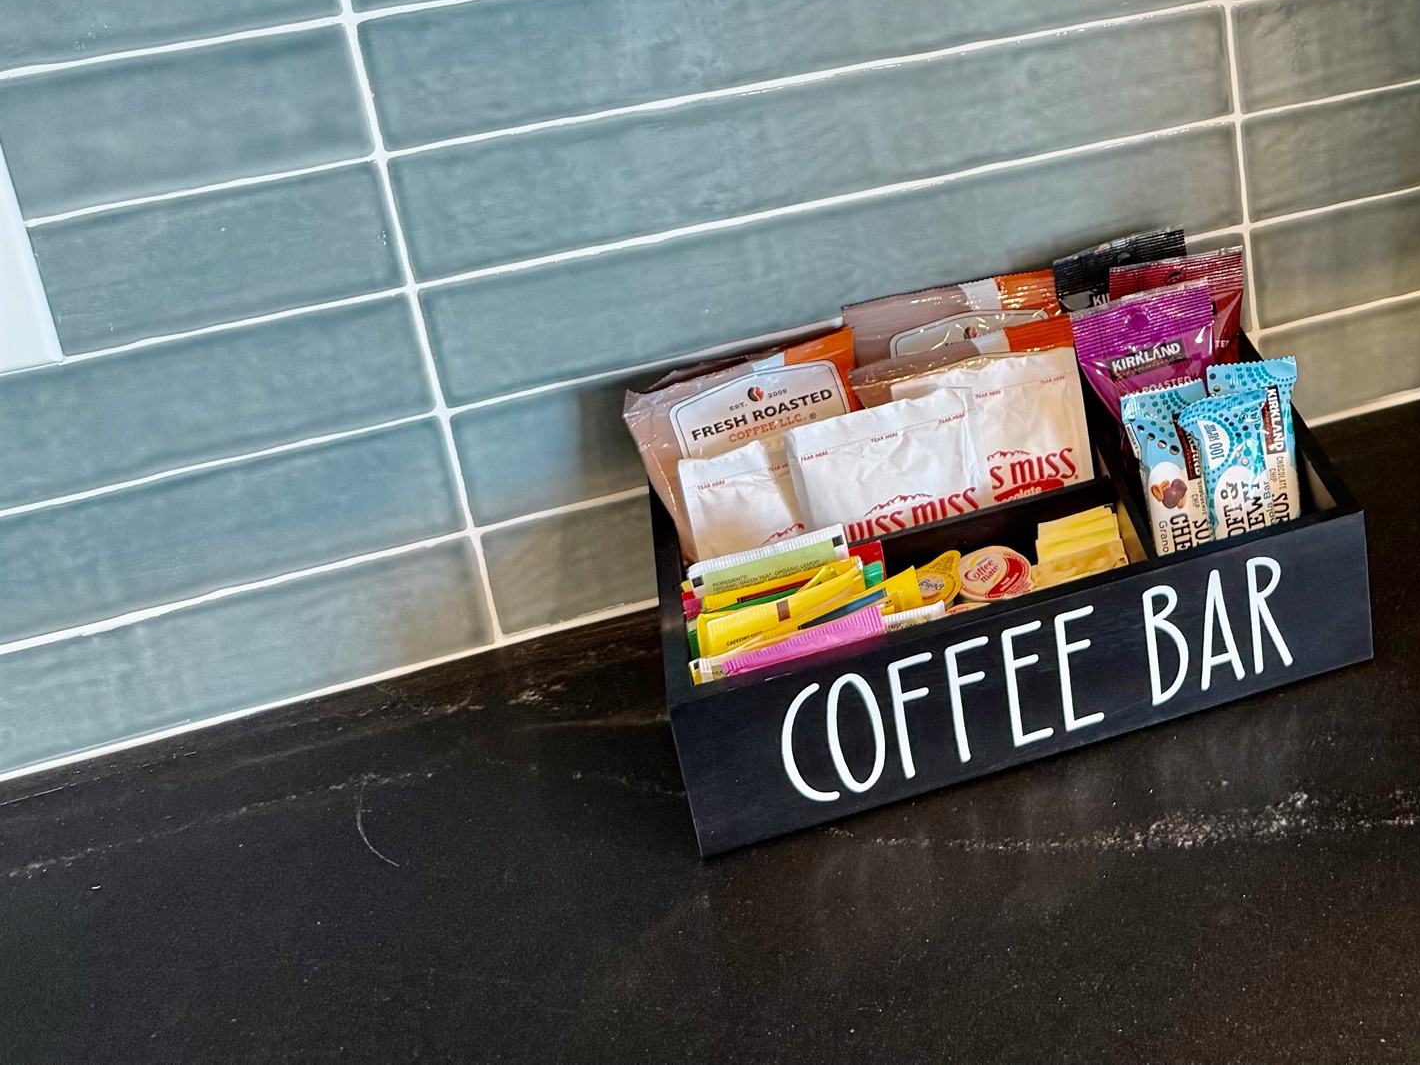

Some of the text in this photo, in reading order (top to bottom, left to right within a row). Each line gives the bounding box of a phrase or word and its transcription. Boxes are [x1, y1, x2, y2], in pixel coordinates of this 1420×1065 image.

[1111, 342, 1182, 373] KIRKLAND
[729, 387, 788, 412] EST. 2009
[691, 388, 833, 442] FRESH ROASTED
[728, 413, 807, 444] COFFEE LLC.
[1266, 386, 1284, 451] KIRKLAND
[1208, 442, 1225, 460] 100
[1010, 447, 1077, 486] MISS
[1268, 467, 1278, 483] CHIP
[1275, 455, 1288, 491] CHOCOLATE
[1191, 493, 1200, 509] CHIP
[1263, 480, 1272, 500] Bar
[910, 486, 979, 527] MISS
[800, 559, 821, 569] LEMON
[964, 559, 995, 582] Coffee
[980, 564, 1000, 584] mate
[781, 557, 1294, 801] COFFEE BAR
